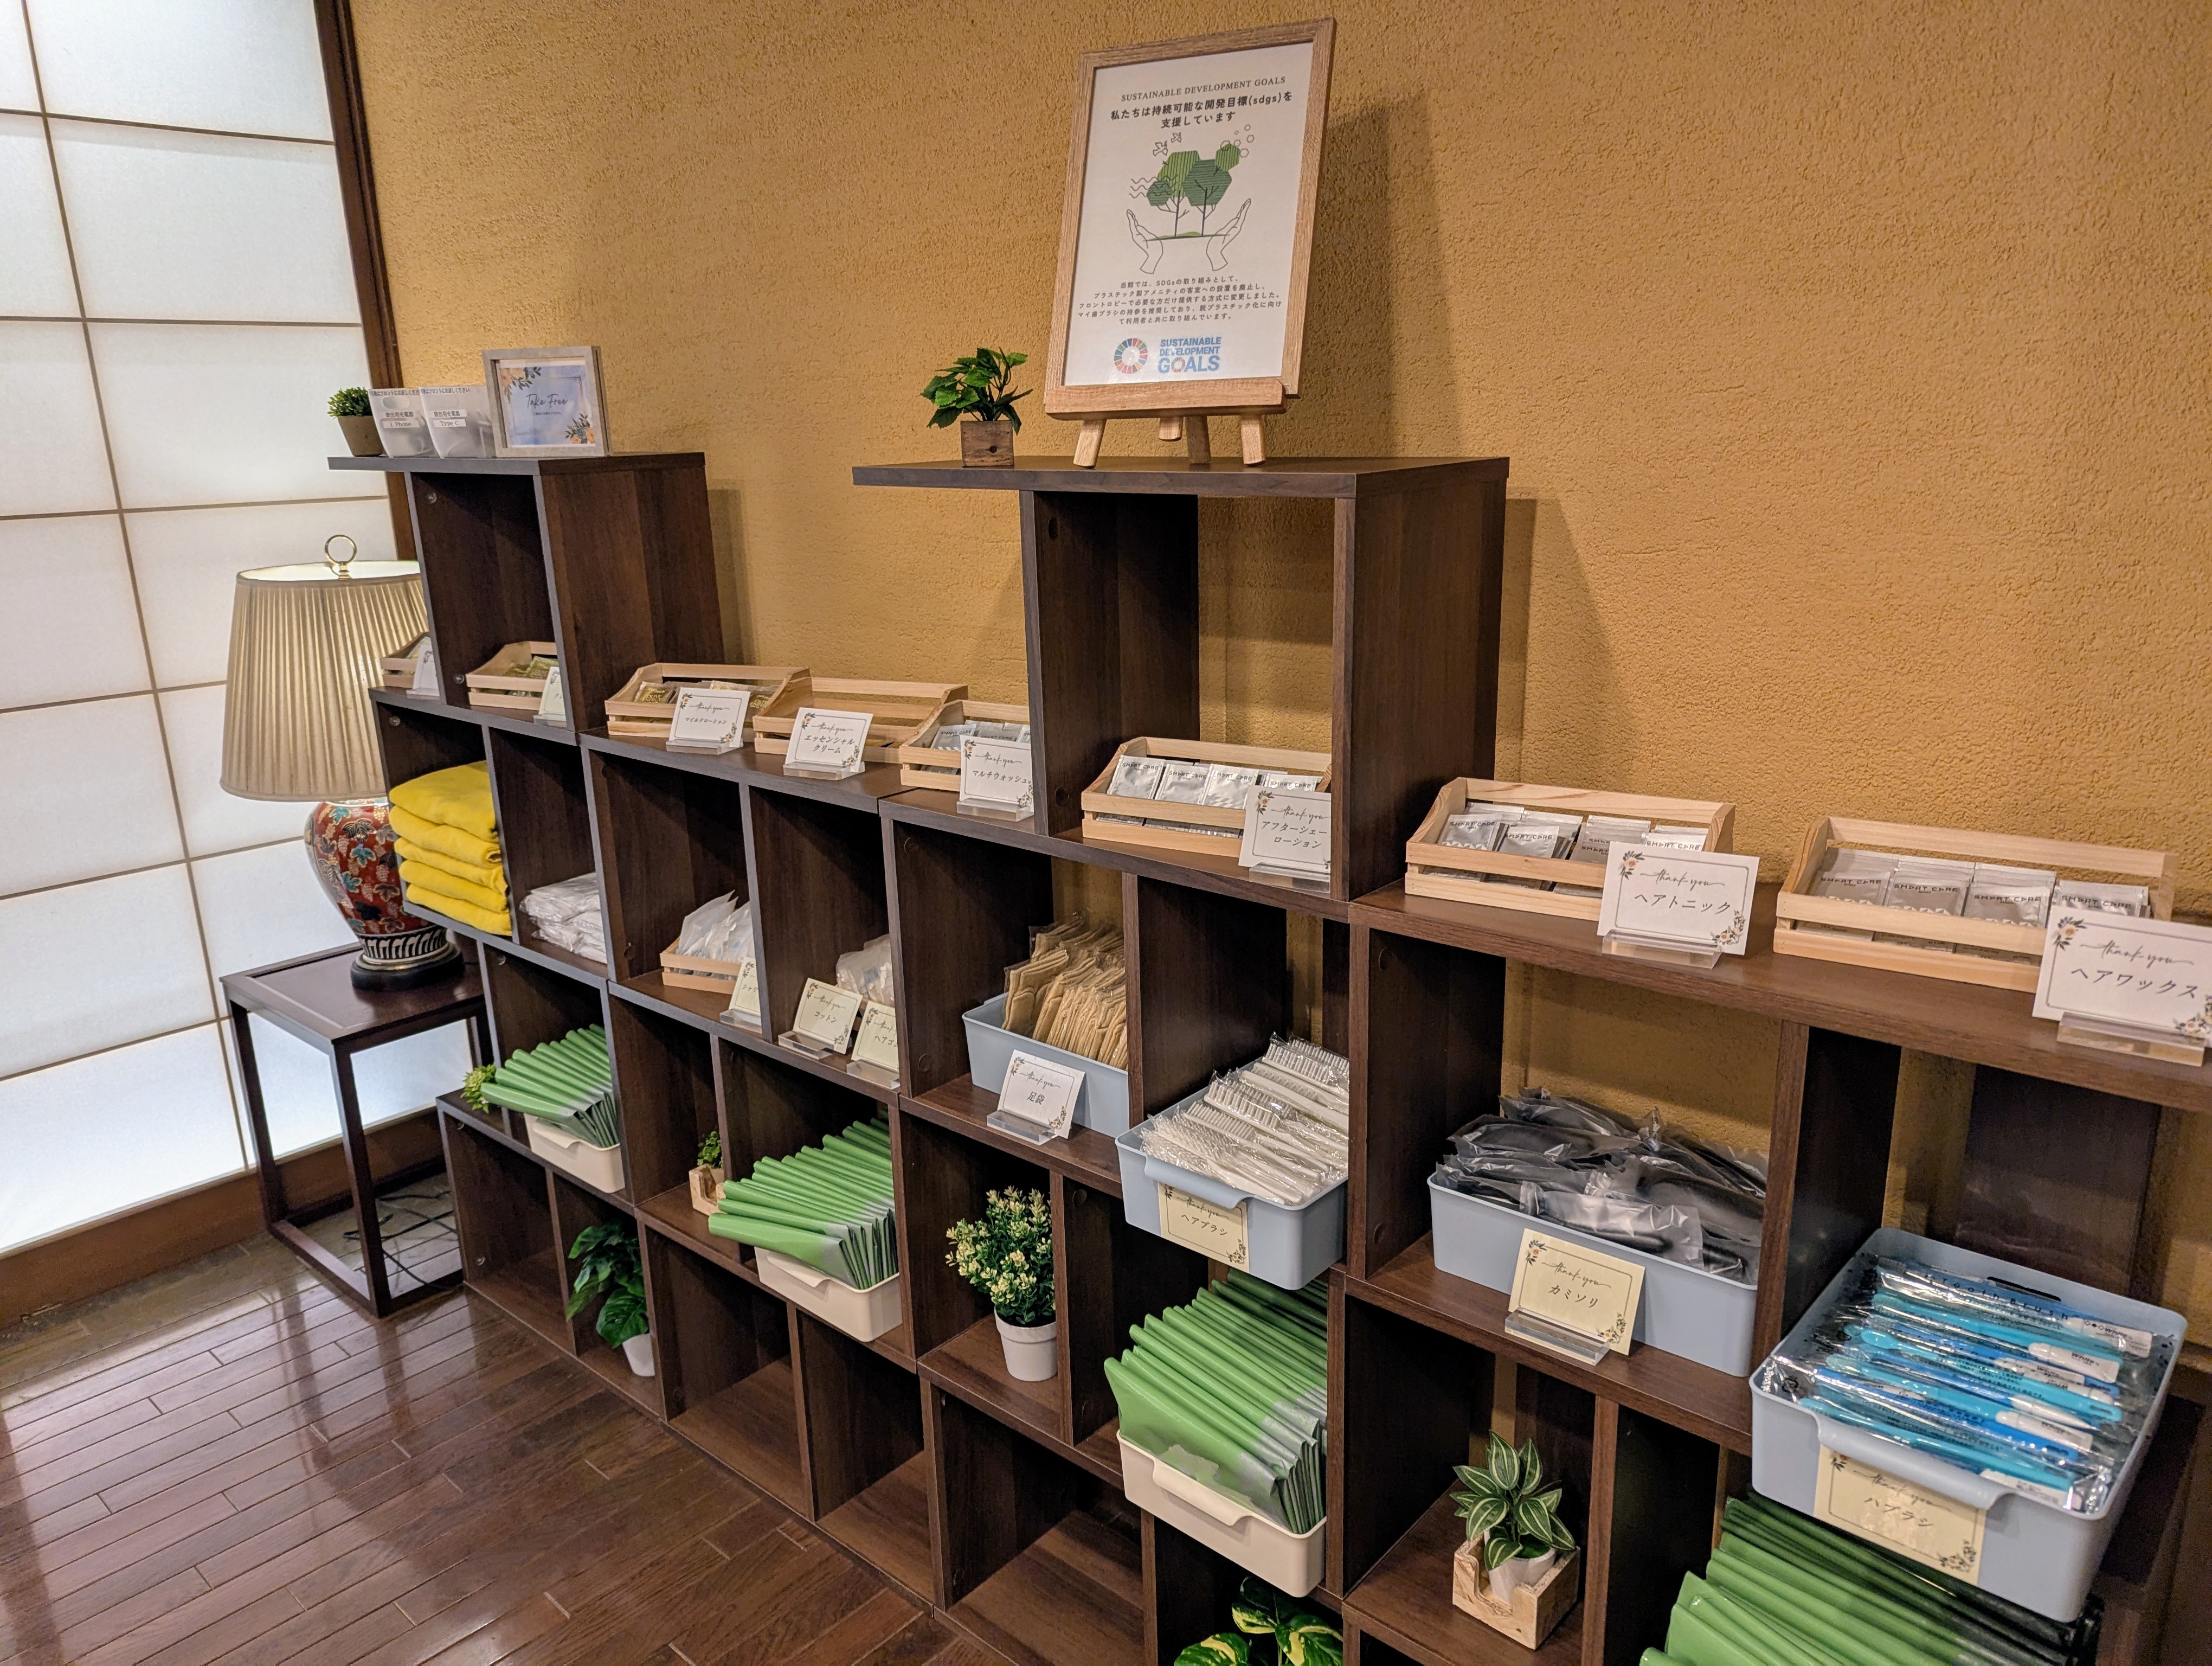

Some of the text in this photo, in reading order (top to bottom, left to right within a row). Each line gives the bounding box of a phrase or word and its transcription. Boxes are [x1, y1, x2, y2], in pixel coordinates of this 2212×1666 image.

[1121, 76, 1285, 102] SUSTAINABLE DEVELOPMENT GOALS
[1110, 91, 1293, 120] 私たちは持続可能な開発目標(sdgs)を
[1161, 111, 1236, 129] 支援しています
[1120, 276, 1238, 289] 当館では、SDGsの取り組みとして、
[1119, 313, 1232, 325] て利用者と共に取り組んでいます。
[1160, 337, 1222, 347] SUSTAINABLE
[1159, 347, 1220, 356] DEVELOPMENT
[1158, 355, 1220, 374] GOALS
[525, 393, 568, 409] Take Free
[811, 722, 835, 733] thank
[804, 735, 856, 745] エッセンシャル
[813, 745, 840, 753] クリーム
[975, 752, 1023, 767] thank you
[973, 770, 1027, 784] マルチウォッシュ
[1271, 805, 1330, 824] thank you
[1274, 837, 1322, 848] ローション
[1640, 868, 1726, 892] thank you
[1634, 894, 1731, 915] ヘアトニック
[2061, 895, 2098, 905] SMART
[2102, 900, 2132, 909] CARE
[2080, 939, 2195, 969] thank you
[2070, 968, 2198, 998] ヘアワックス
[814, 1011, 838, 1023] コットン
[1020, 1071, 1061, 1090] thank you
[1026, 1091, 1045, 1105] 足袋
[1176, 1196, 1230, 1220] thank you
[1181, 1214, 1228, 1235] ヘアブラシ
[1541, 1261, 1612, 1289] thank you
[1548, 1284, 1598, 1308] カミソリ
